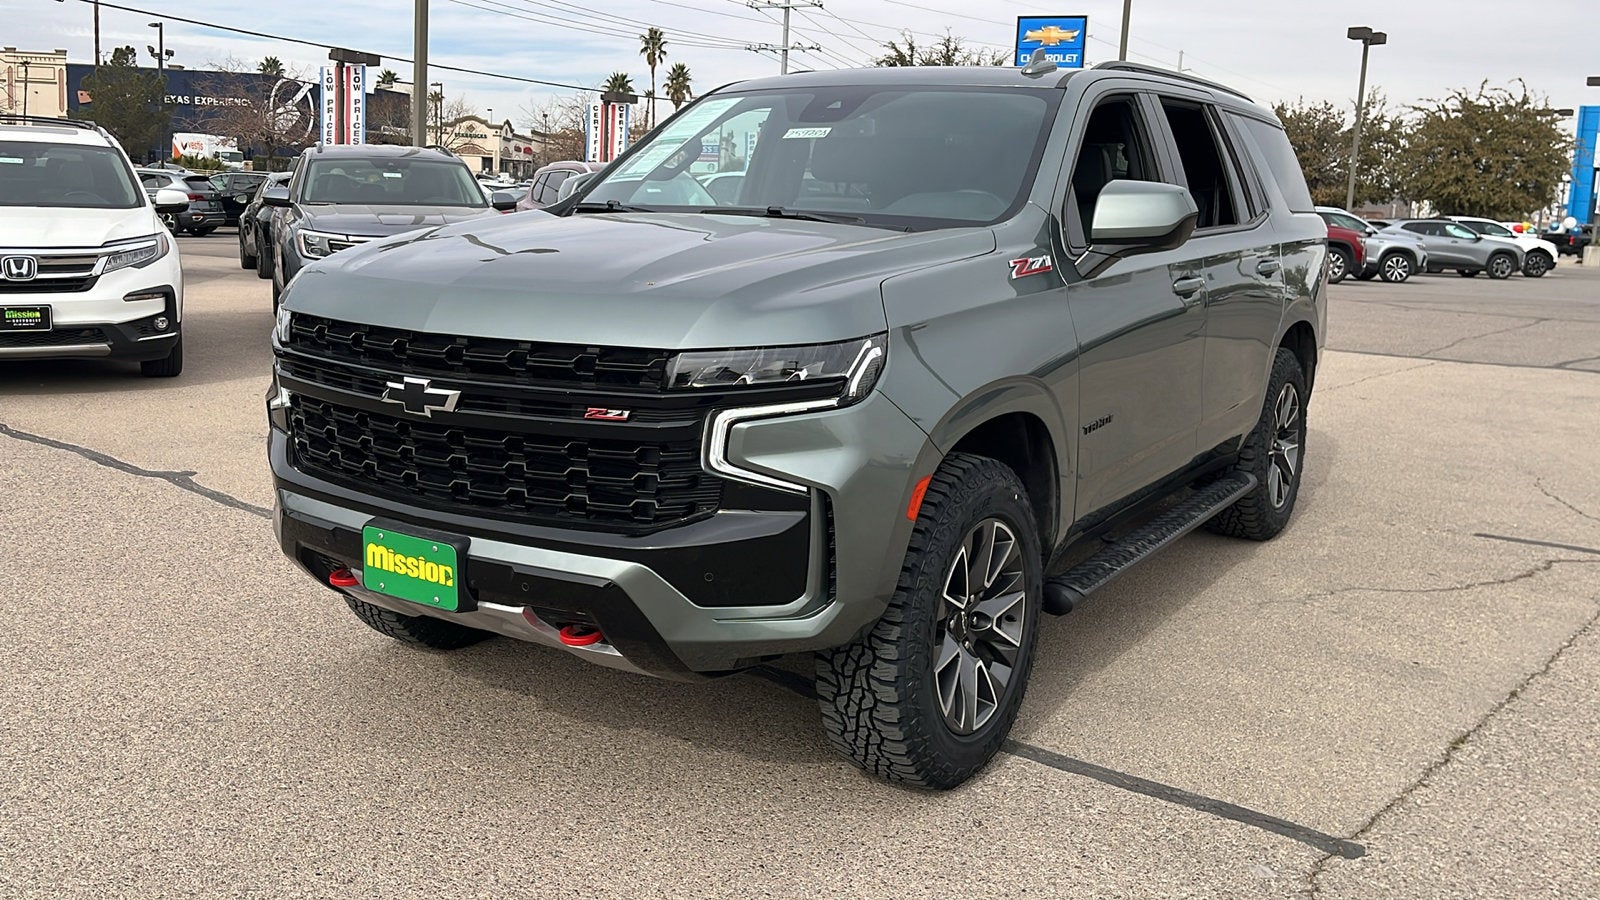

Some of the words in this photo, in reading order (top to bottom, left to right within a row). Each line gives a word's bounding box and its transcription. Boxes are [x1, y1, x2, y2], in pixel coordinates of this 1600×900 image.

[1020, 53, 1078, 63] CHROLET
[353, 68, 361, 91] LOW
[164, 95, 190, 105] EXAS
[353, 99, 361, 145] PRICES
[1008, 255, 1052, 279] Z71
[5, 310, 41, 319] Mission
[584, 407, 631, 421] Z71
[366, 542, 454, 587] Mission
